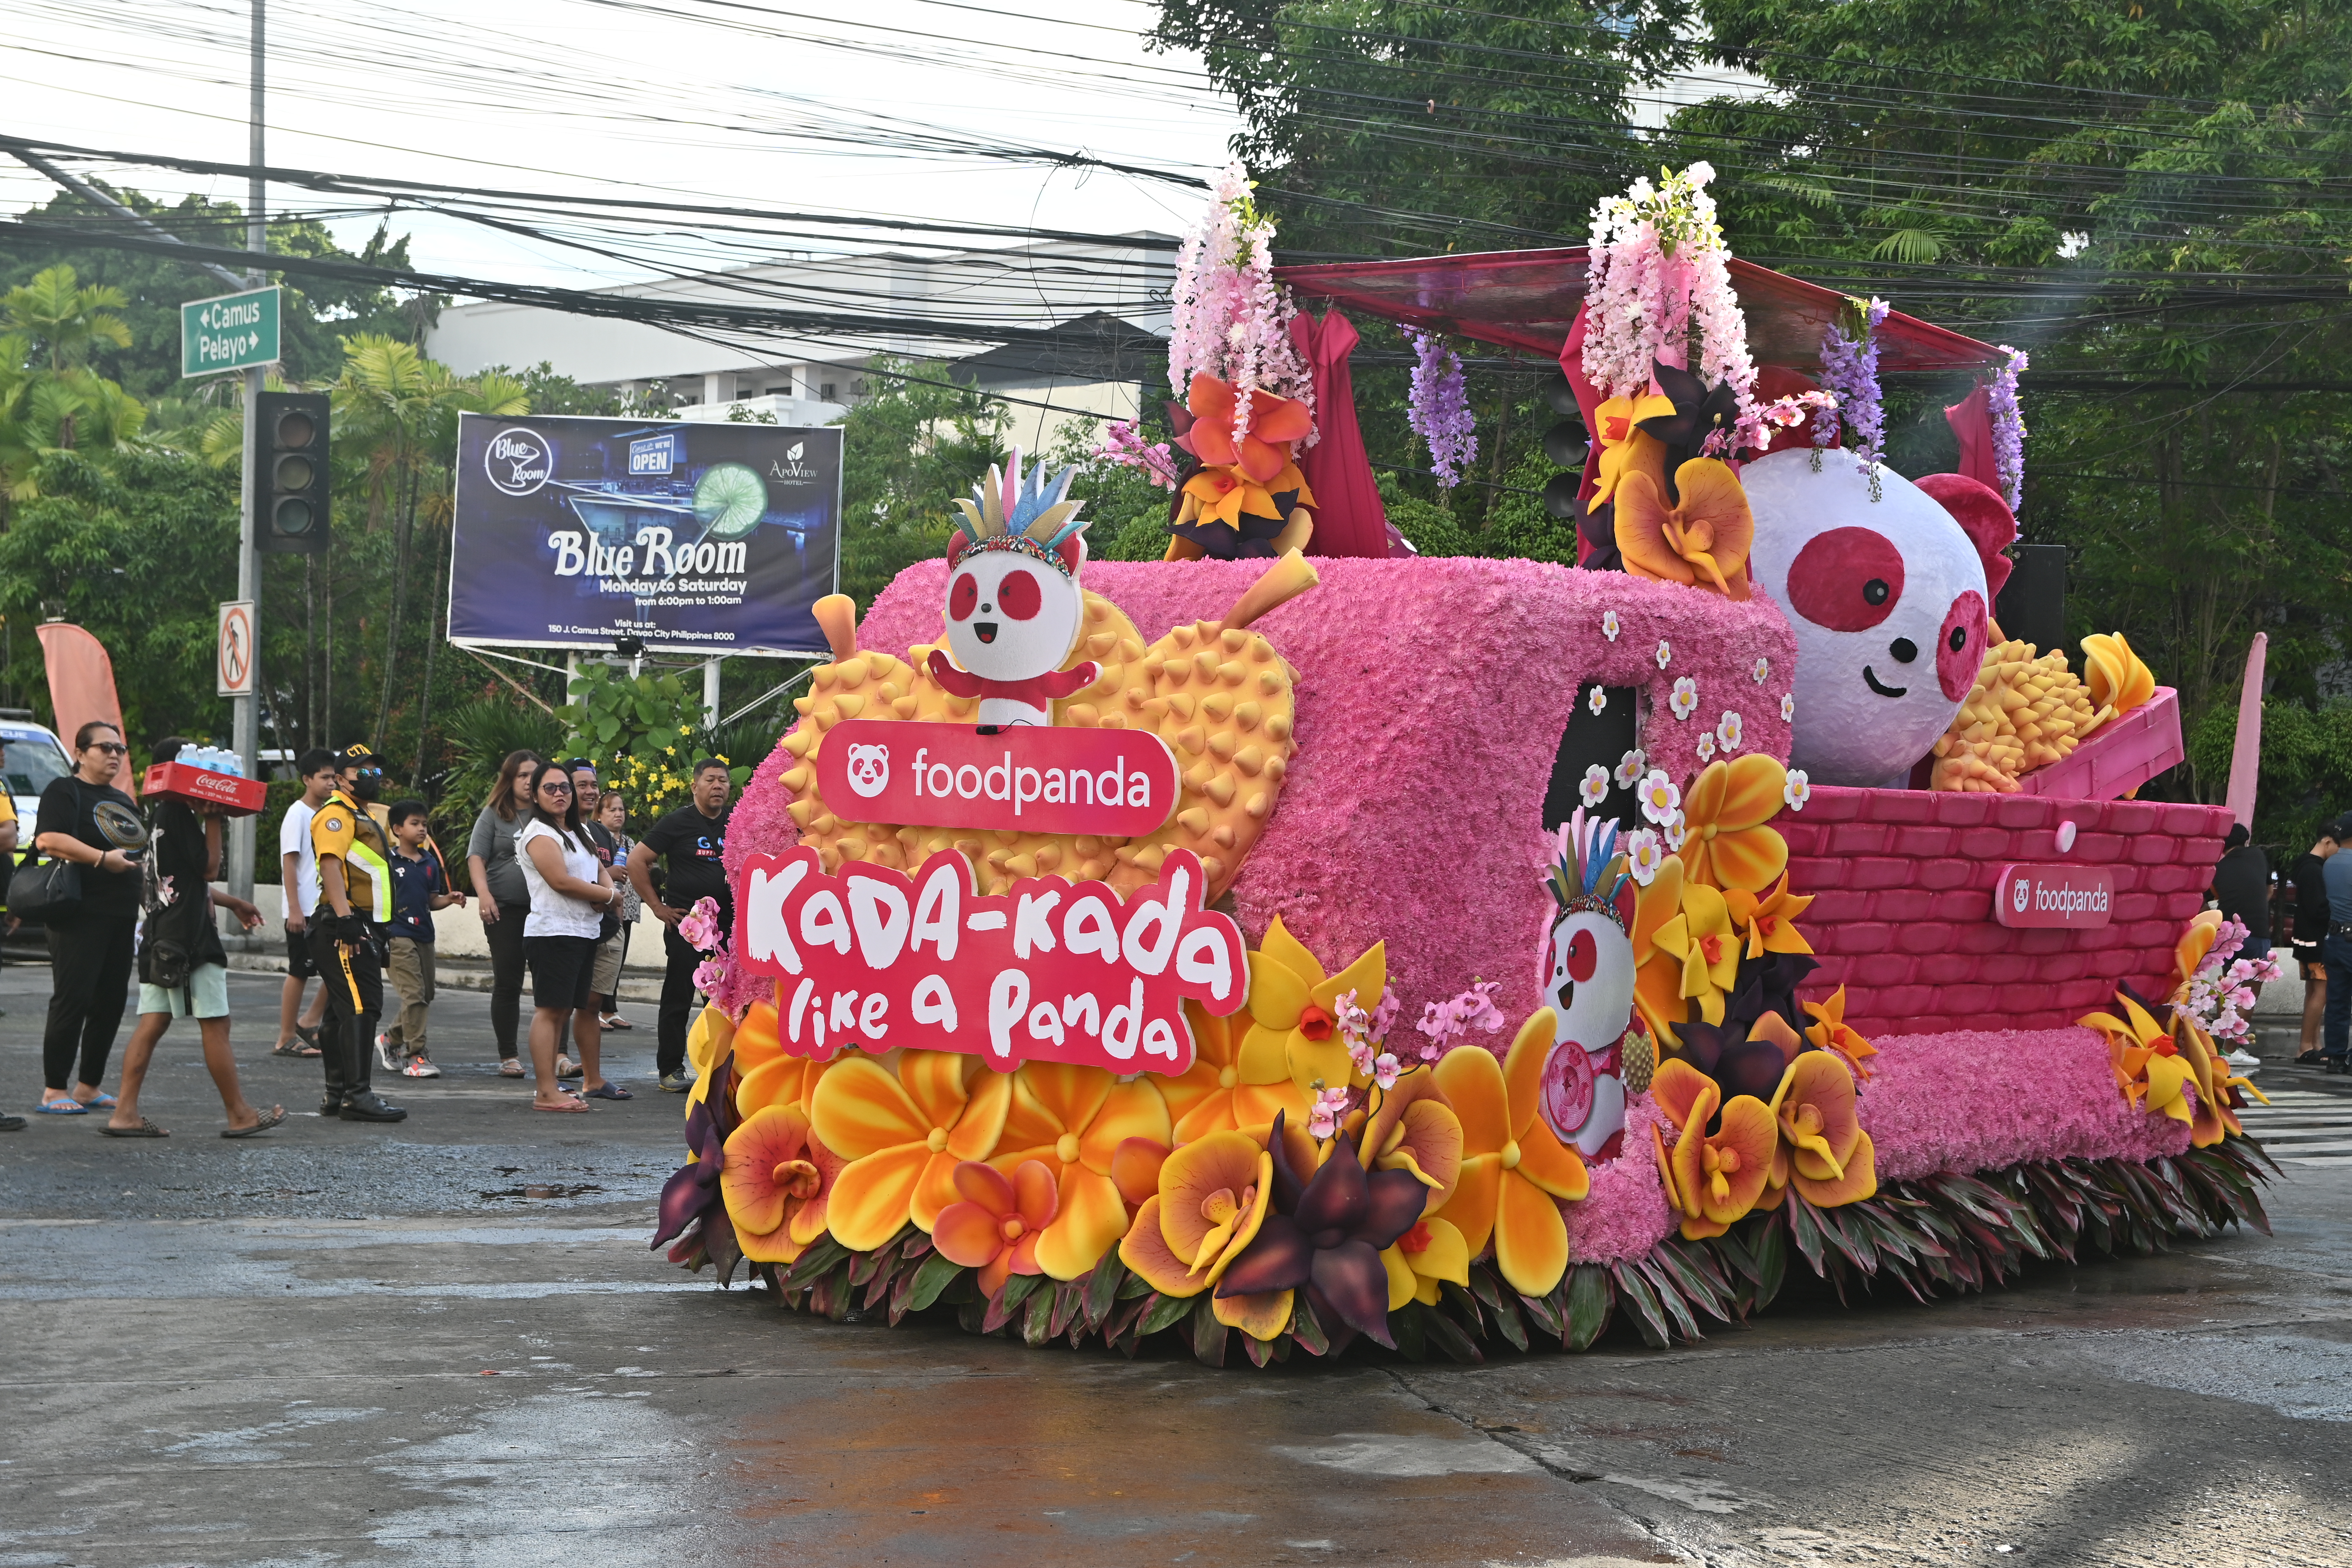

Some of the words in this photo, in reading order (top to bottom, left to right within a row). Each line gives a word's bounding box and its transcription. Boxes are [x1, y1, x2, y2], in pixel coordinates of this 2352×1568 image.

[212, 302, 260, 329] Camus
[200, 333, 247, 364] Pelayo
[495, 438, 528, 460] Blue
[655, 441, 670, 449] WE'RE
[633, 452, 667, 471] OPEN
[512, 466, 546, 483] Room
[548, 531, 634, 576] Blue
[636, 527, 747, 575] Room
[600, 578, 658, 594] Monday
[659, 579, 675, 592] to
[678, 578, 747, 594] Saturday
[635, 597, 656, 606] from
[658, 596, 694, 607] 6:00pm
[696, 596, 705, 605] to
[707, 596, 741, 604] 1:00am
[548, 624, 562, 633] 150
[563, 625, 570, 633] J.
[572, 626, 599, 634] Camus
[627, 629, 653, 637] Davao
[654, 629, 670, 639] City
[671, 630, 712, 640] Philippines
[713, 632, 735, 640] 8000
[615, 619, 632, 628] Visit
[196, 774, 240, 793] Coca-Cola
[912, 747, 1150, 816] foodpanda
[2035, 880, 2108, 920] foodpanda
